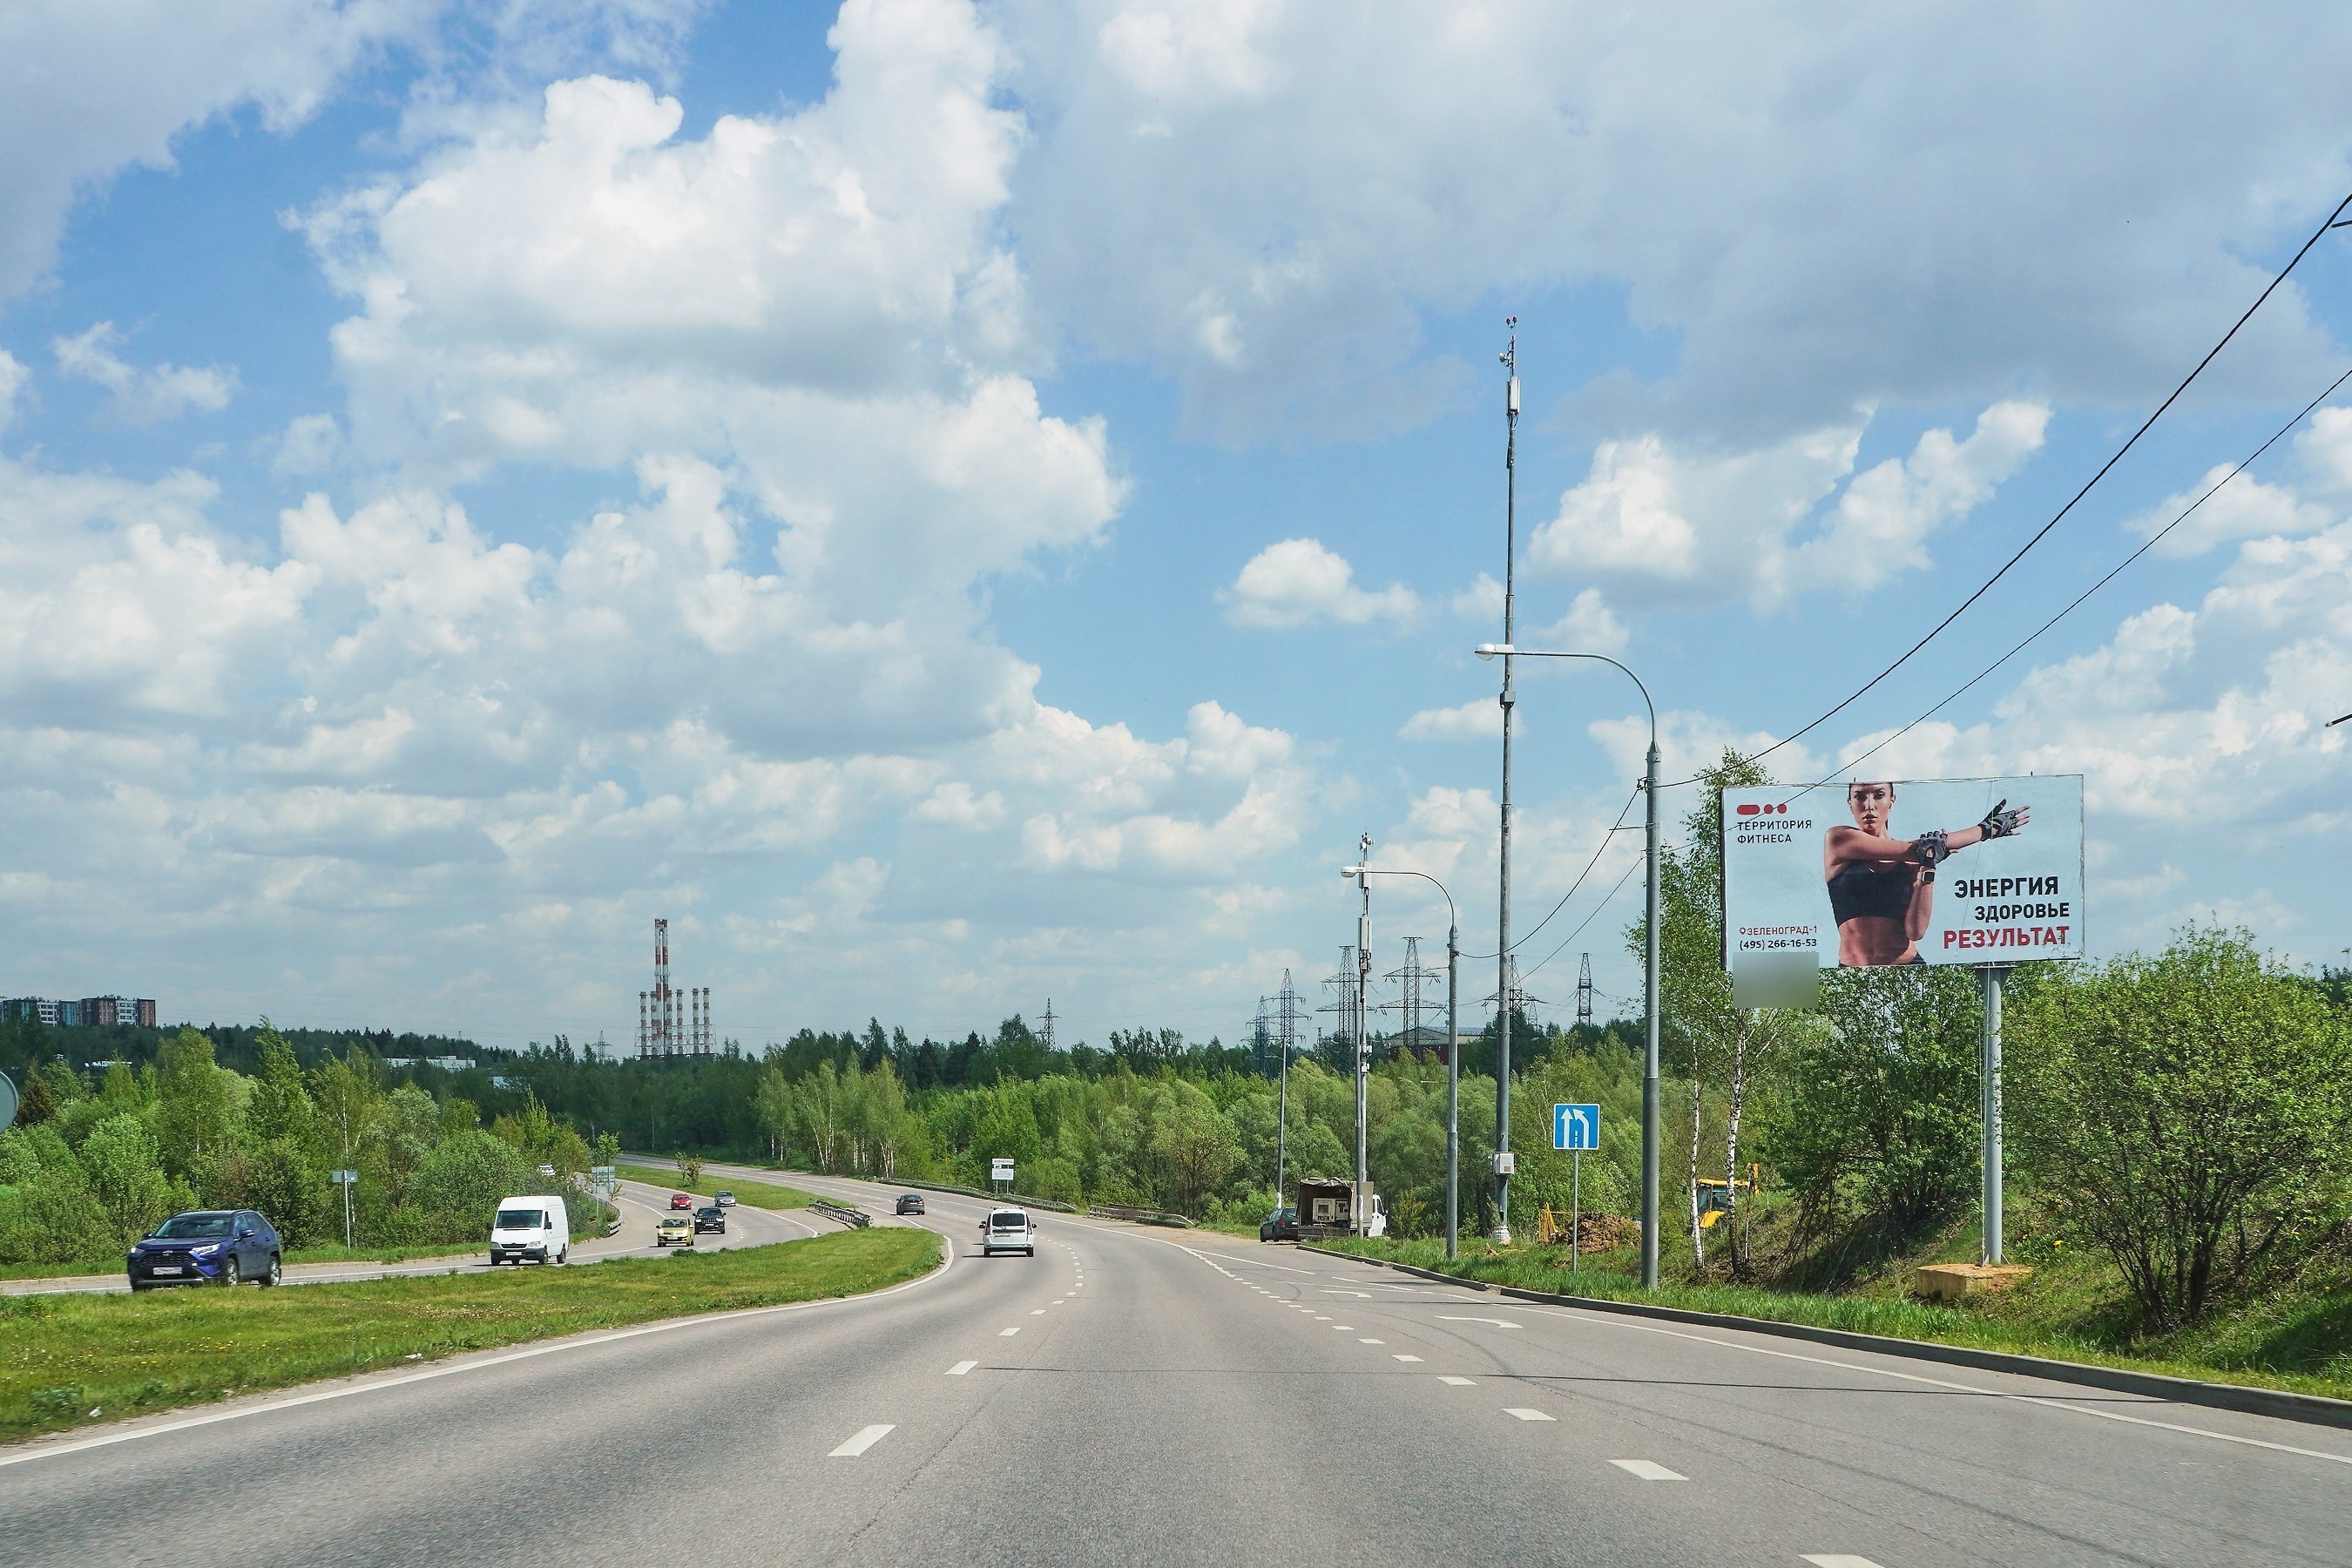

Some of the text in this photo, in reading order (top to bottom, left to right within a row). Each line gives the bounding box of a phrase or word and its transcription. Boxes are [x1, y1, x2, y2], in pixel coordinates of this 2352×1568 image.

[1737, 820, 1812, 830] ТЕРРИТОРИЯ
[1737, 834, 1792, 843] ФИТНЕСА
[1954, 876, 2058, 898] ЭНЕРГИЯ
[1975, 902, 2070, 923] ЗДОРОВЬЕ
[1747, 926, 1817, 936] ЗЕЛЕНОГРАД-1
[1943, 926, 2070, 949] РЕЗУЛЬТАТ
[1740, 938, 1817, 950] (495) 266-16-53
